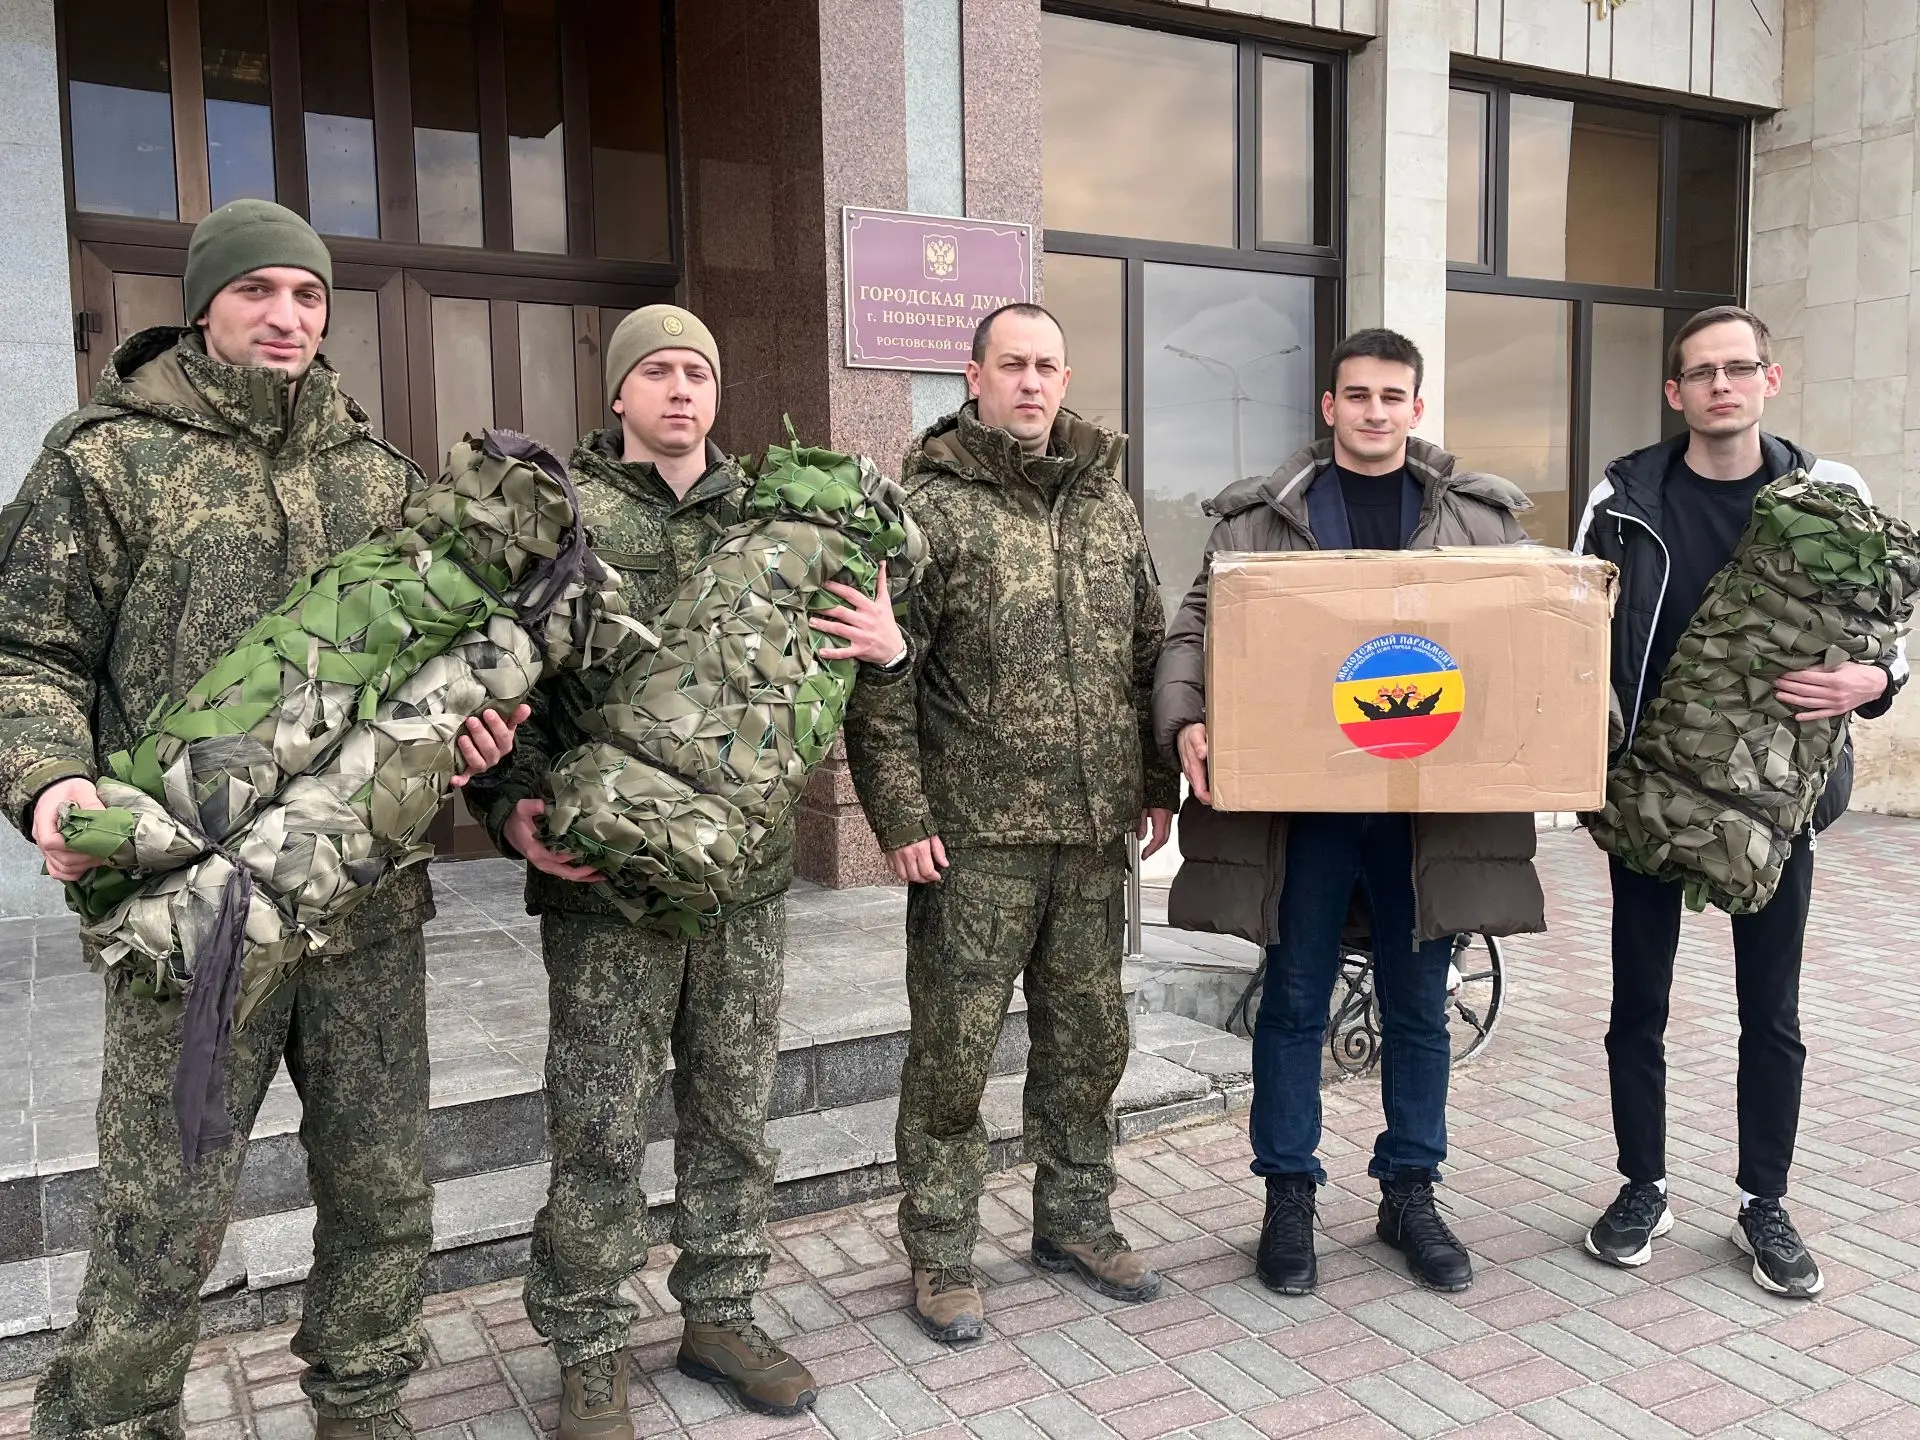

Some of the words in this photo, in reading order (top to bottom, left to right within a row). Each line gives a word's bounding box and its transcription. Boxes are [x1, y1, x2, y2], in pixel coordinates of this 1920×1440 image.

[860, 285, 965, 308] ГОРОДСКАЯ
[867, 312, 877, 323] г.
[876, 336, 952, 350] РОСТОВСКОЙ
[1400, 636, 1457, 668] ПАРЛАМЕНТ
